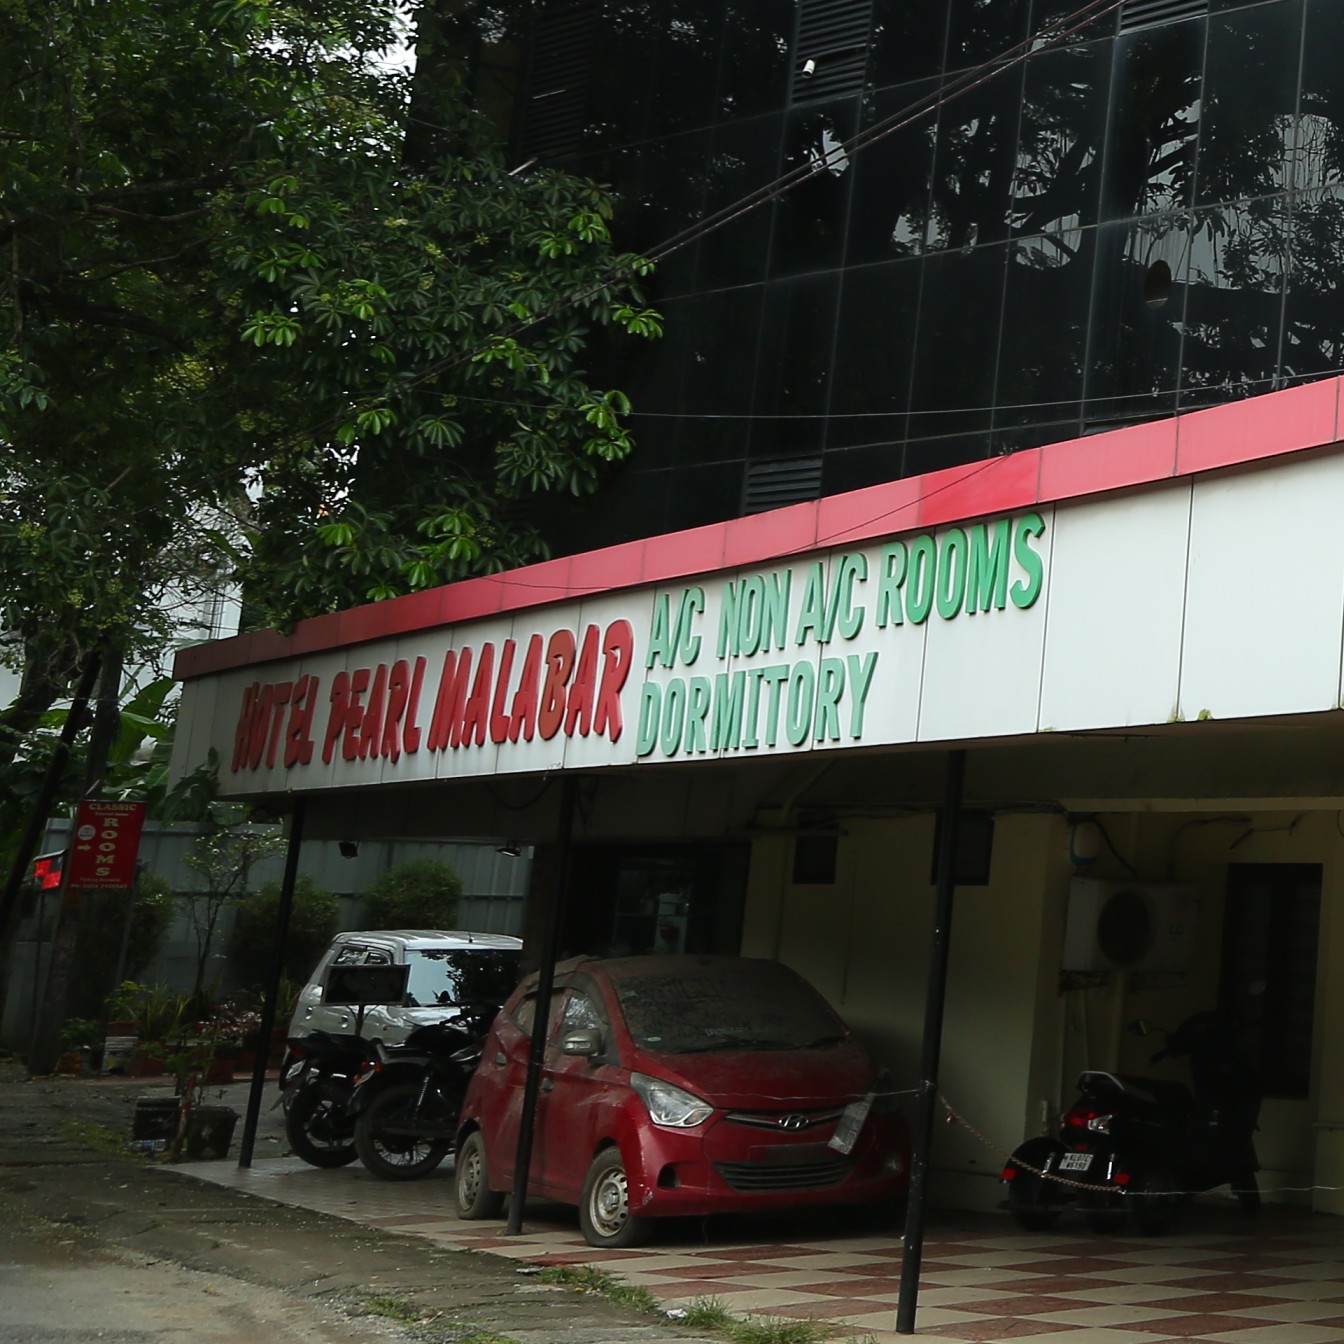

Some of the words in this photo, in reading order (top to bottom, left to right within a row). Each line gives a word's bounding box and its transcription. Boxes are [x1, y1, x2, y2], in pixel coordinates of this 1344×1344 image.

[645, 586, 706, 670] A/C
[716, 567, 793, 660] NON
[796, 551, 868, 646] A/C
[875, 511, 1046, 630] ROOMS
[231, 674, 320, 773] HOTEL
[321, 656, 427, 764] PEARL
[426, 619, 635, 752] MALABAR
[636, 651, 880, 758] DORMITORY
[89, 803, 137, 811] CLASSIC
[95, 817, 120, 877] ROOMS
